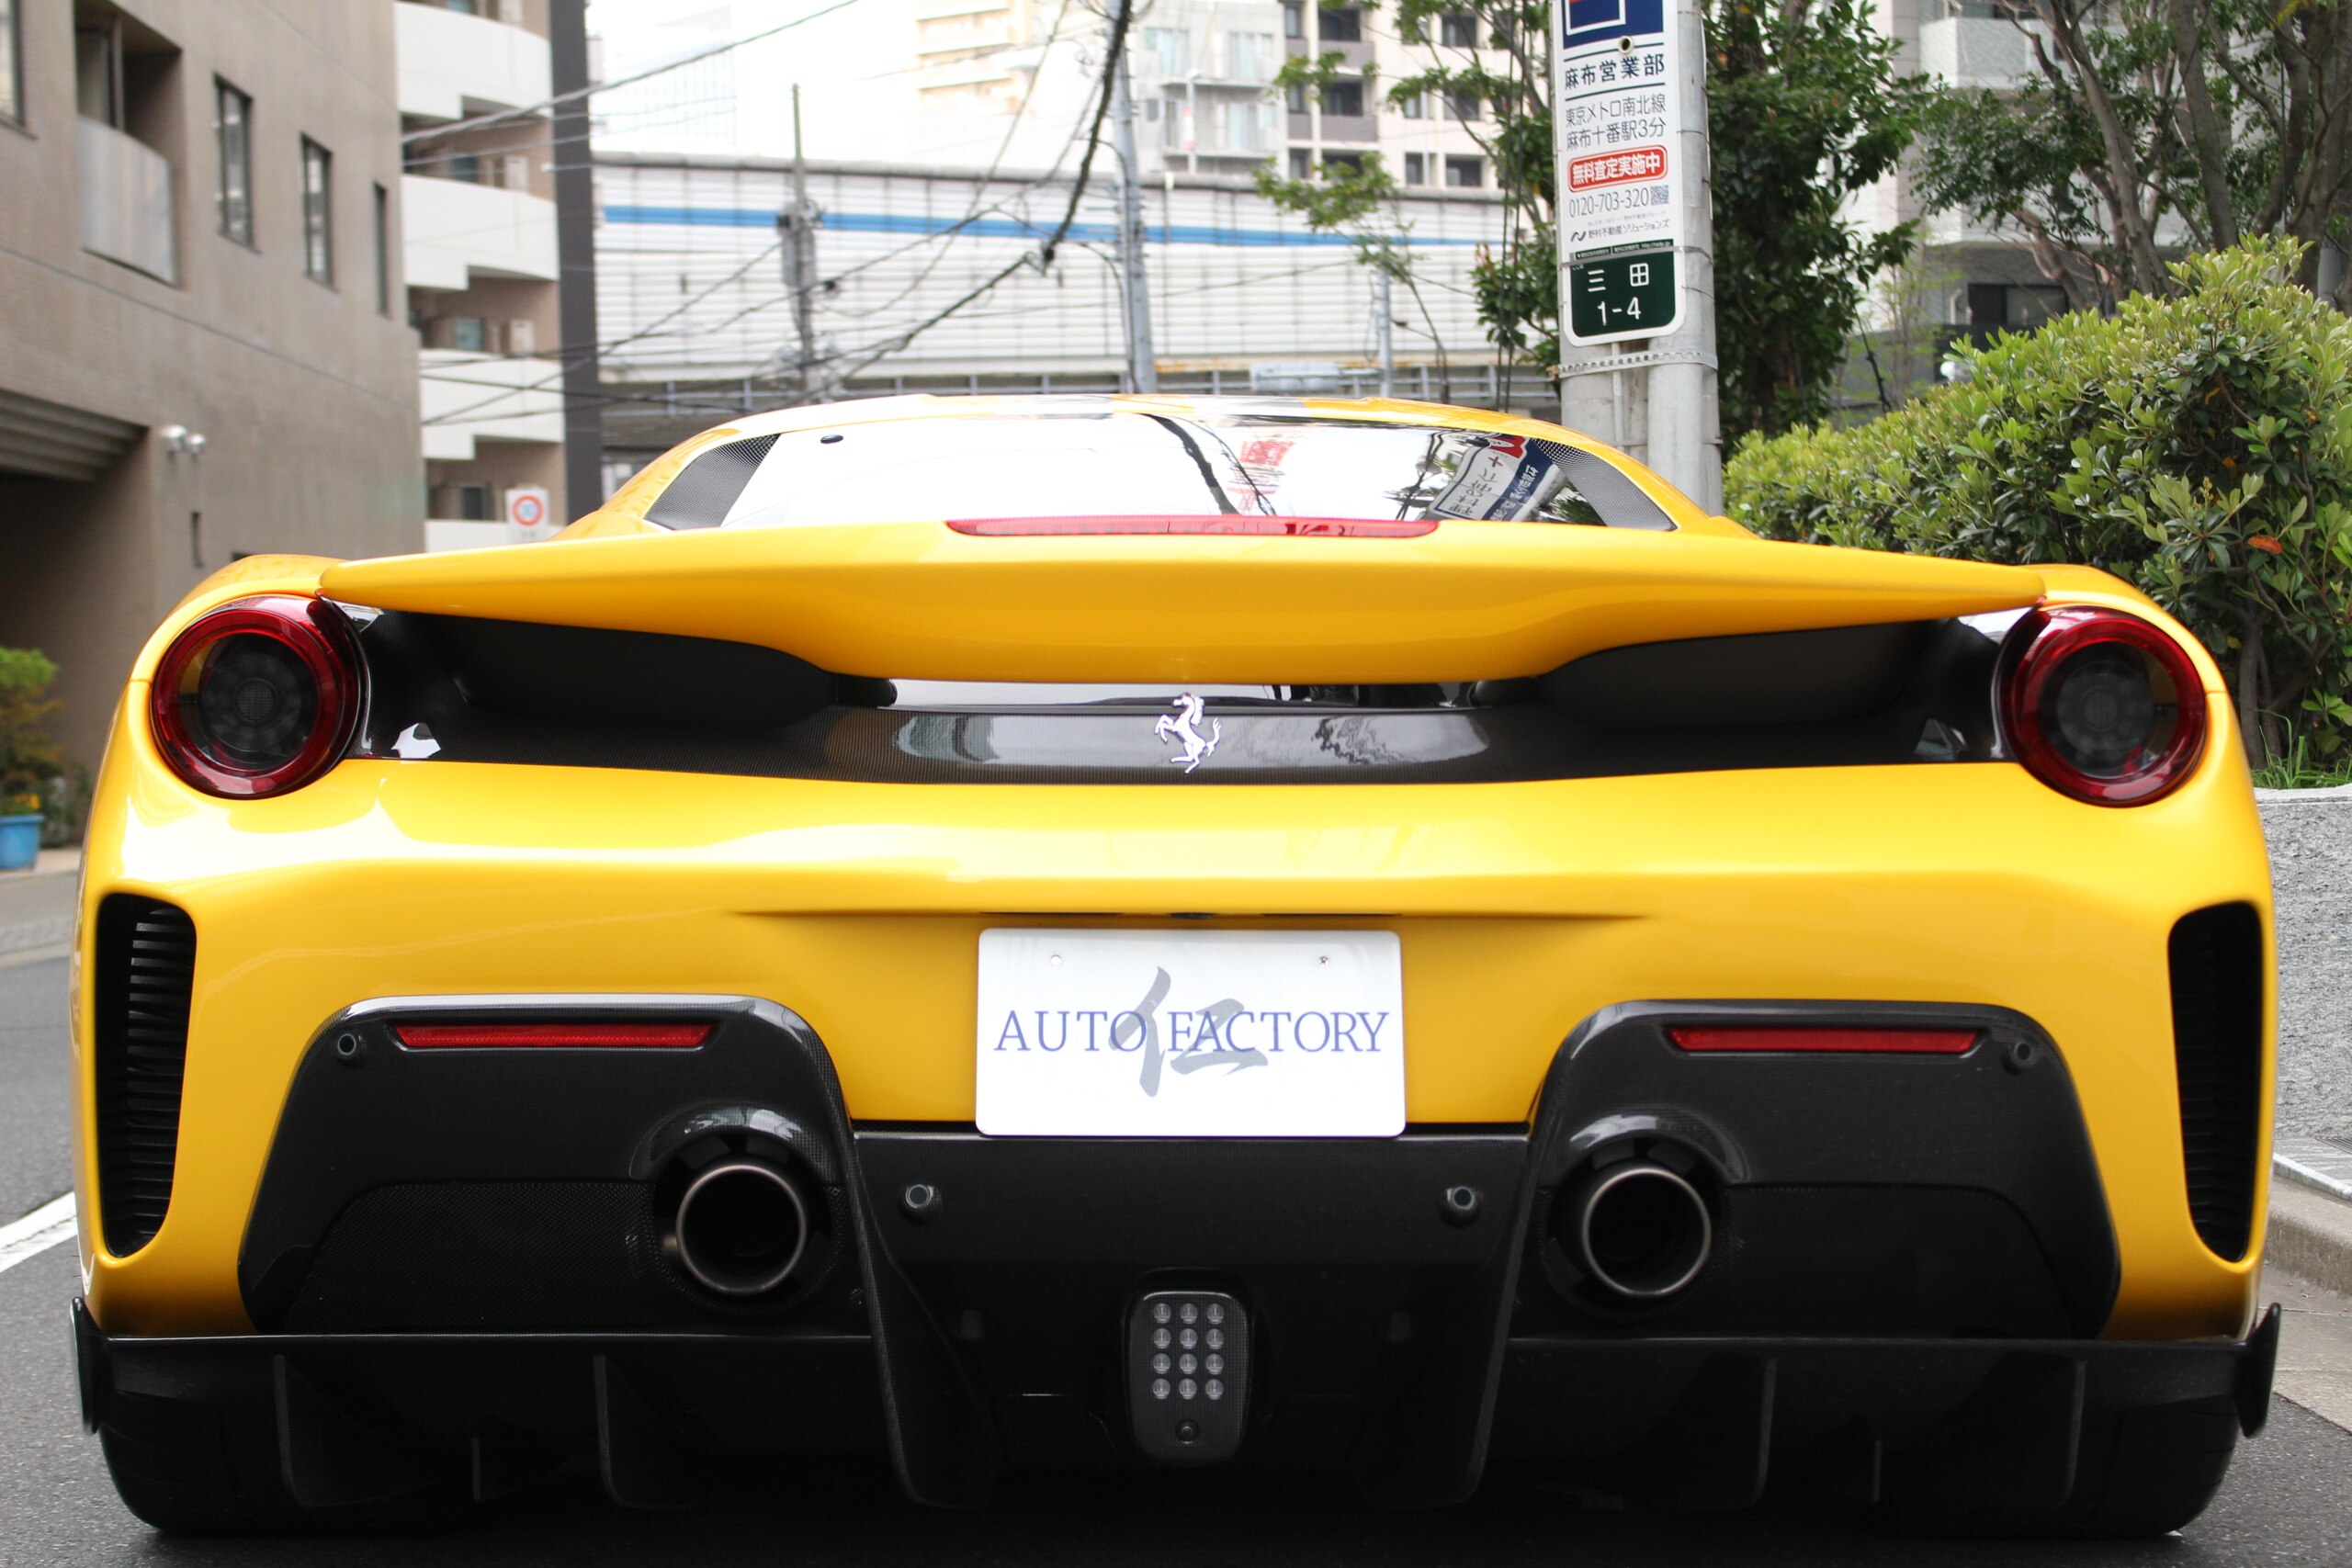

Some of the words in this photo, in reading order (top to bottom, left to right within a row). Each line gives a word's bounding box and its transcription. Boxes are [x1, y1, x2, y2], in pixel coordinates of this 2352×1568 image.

[1565, 53, 1665, 90] 麻布営業部
[1566, 93, 1667, 128] 東京メトロ南北線
[1566, 117, 1667, 151] 麻布十番駅3分
[1572, 152, 1660, 185] 無料査定実施中
[1569, 187, 1649, 218] 0120-703-320
[1588, 263, 1650, 292] 三田
[1597, 297, 1642, 326] 1-4
[994, 1010, 1148, 1053] AUTO
[1167, 1010, 1390, 1053] FACTORY
